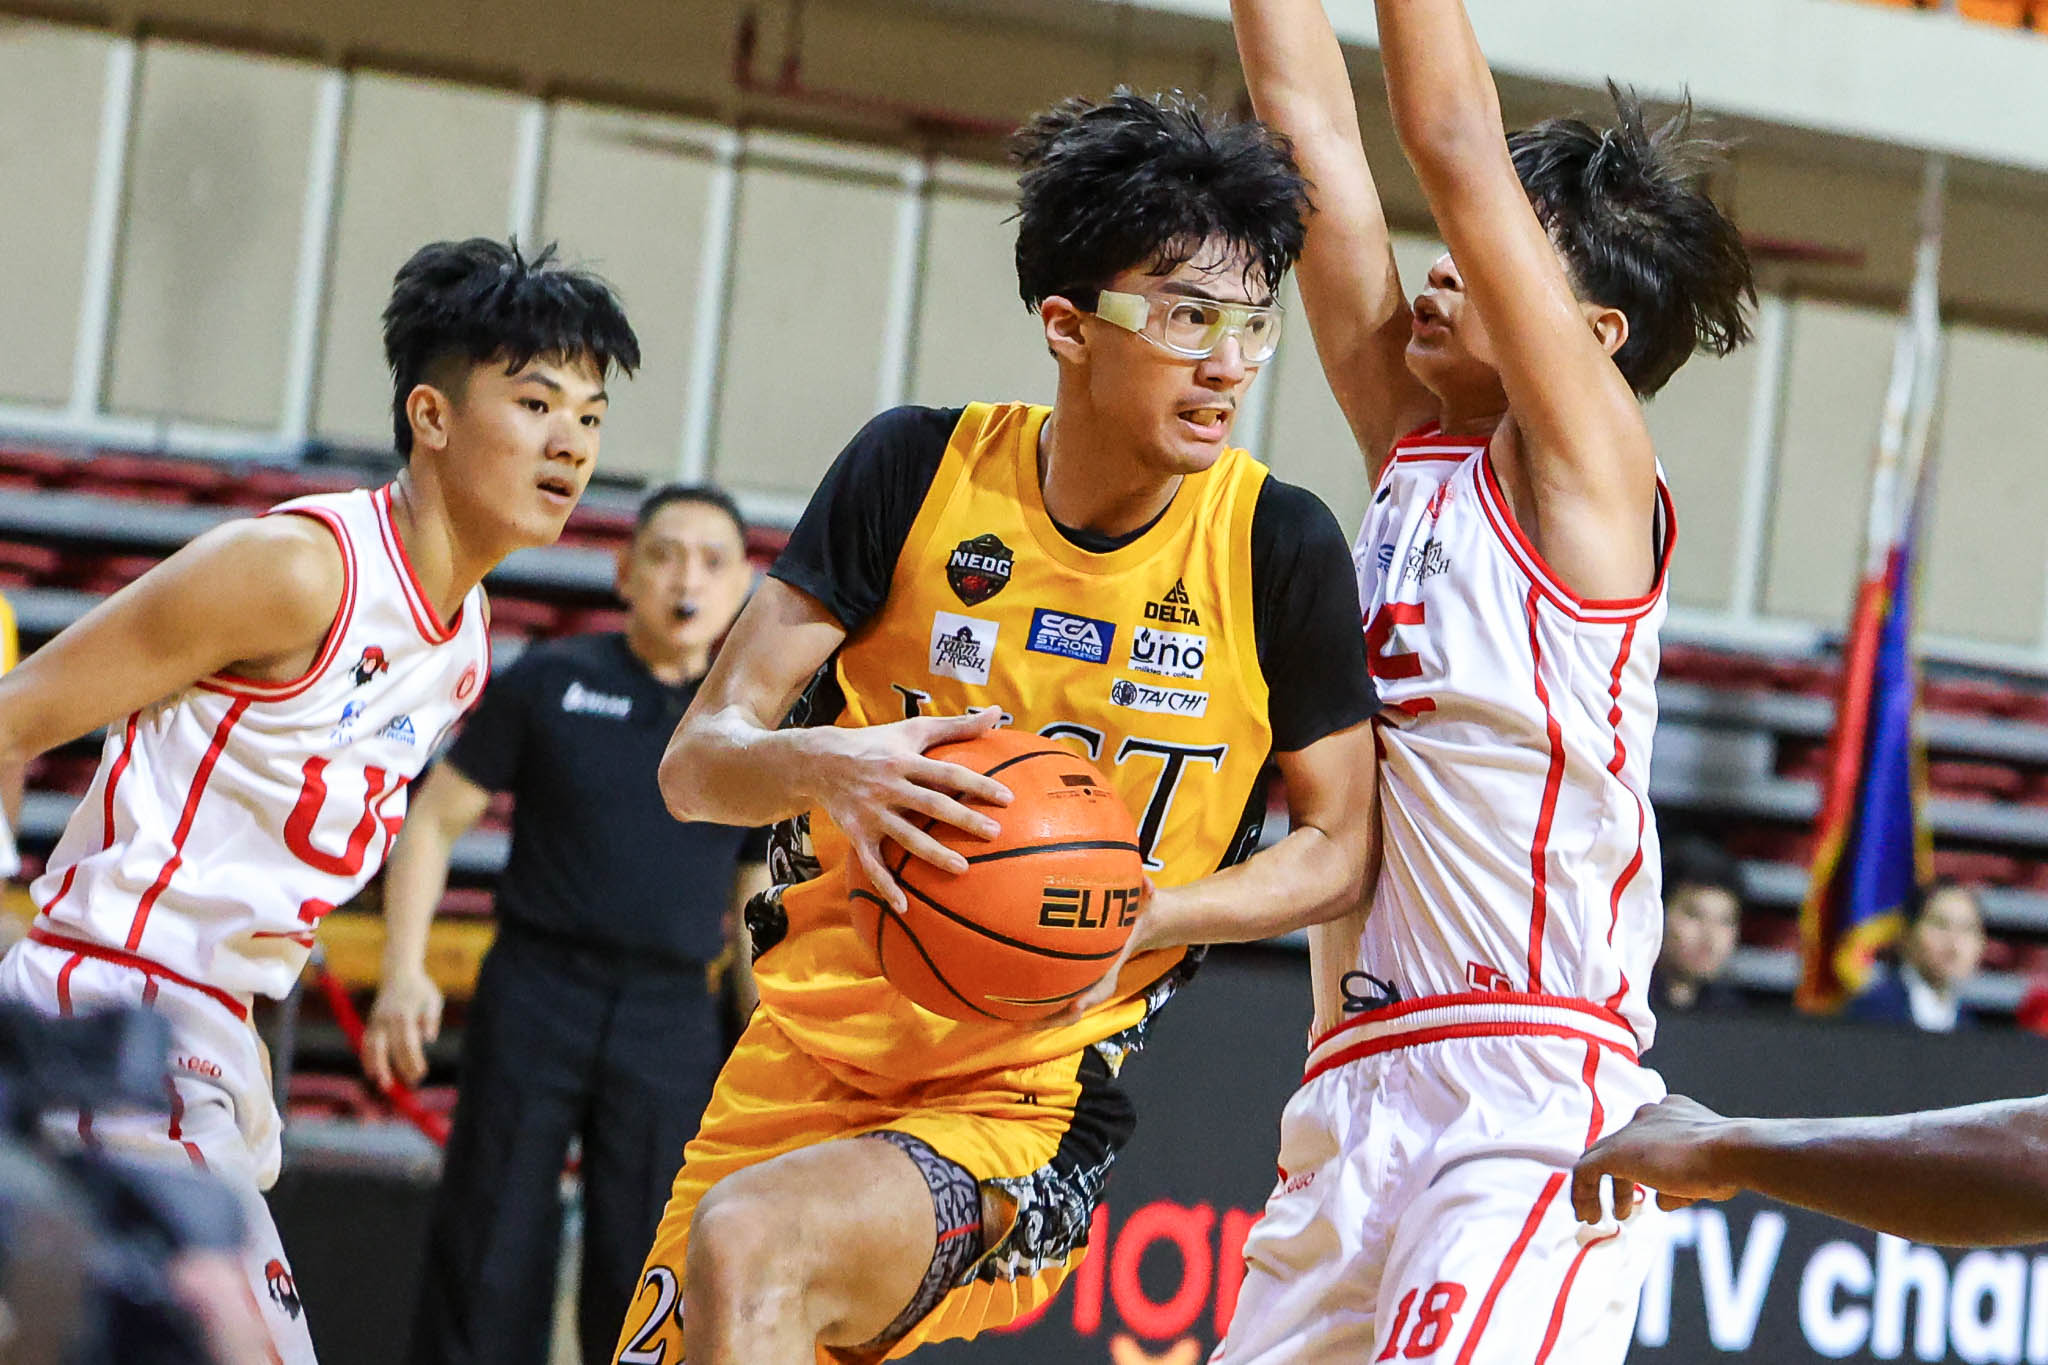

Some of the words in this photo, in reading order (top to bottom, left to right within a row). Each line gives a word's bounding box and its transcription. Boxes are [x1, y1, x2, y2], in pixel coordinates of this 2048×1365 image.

[950, 551, 1011, 577] NEDG
[1038, 613, 1103, 647] SGA
[1144, 601, 1200, 626] DELTA
[1036, 634, 1102, 656] STRONG
[1037, 886, 1140, 930] ELITE
[1636, 1206, 1788, 1352] TV
[1799, 1231, 2048, 1365] cha
[616, 1264, 685, 1365] 2
[1376, 1281, 1468, 1363] 18
